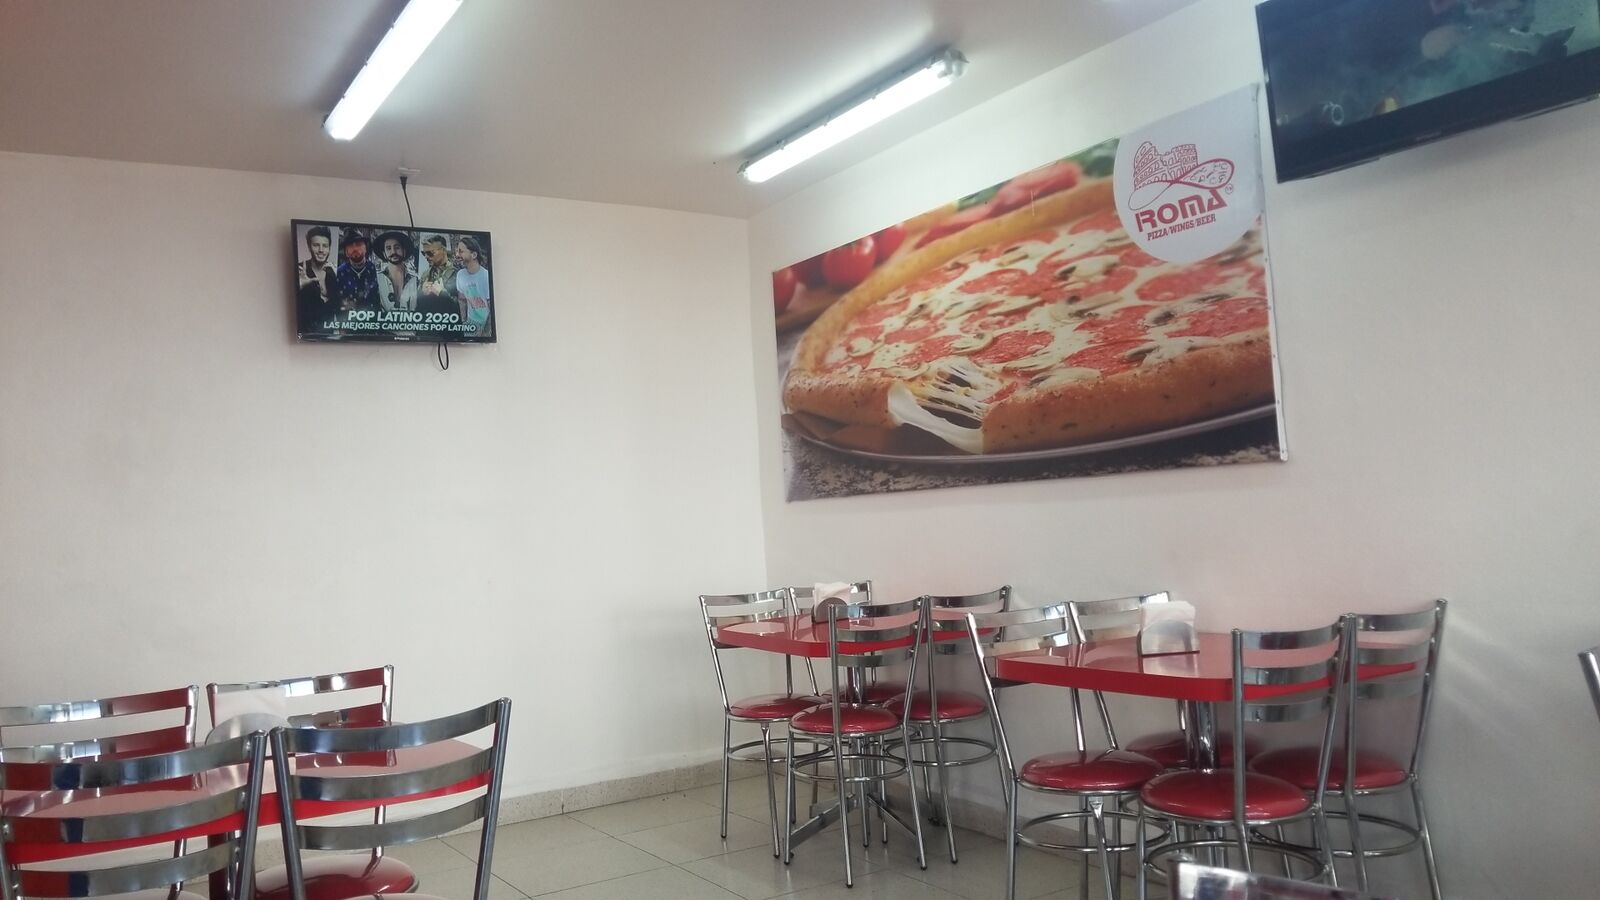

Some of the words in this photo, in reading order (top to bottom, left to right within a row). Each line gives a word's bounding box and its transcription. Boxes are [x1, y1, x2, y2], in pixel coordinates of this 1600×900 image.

[1135, 189, 1227, 232] ROMA
[347, 311, 375, 321] POP
[377, 311, 423, 322] LATINO
[425, 312, 459, 323] 2020
[323, 321, 340, 329] LAS
[341, 321, 380, 330] MEJORES
[381, 323, 429, 331] CANCIONES
